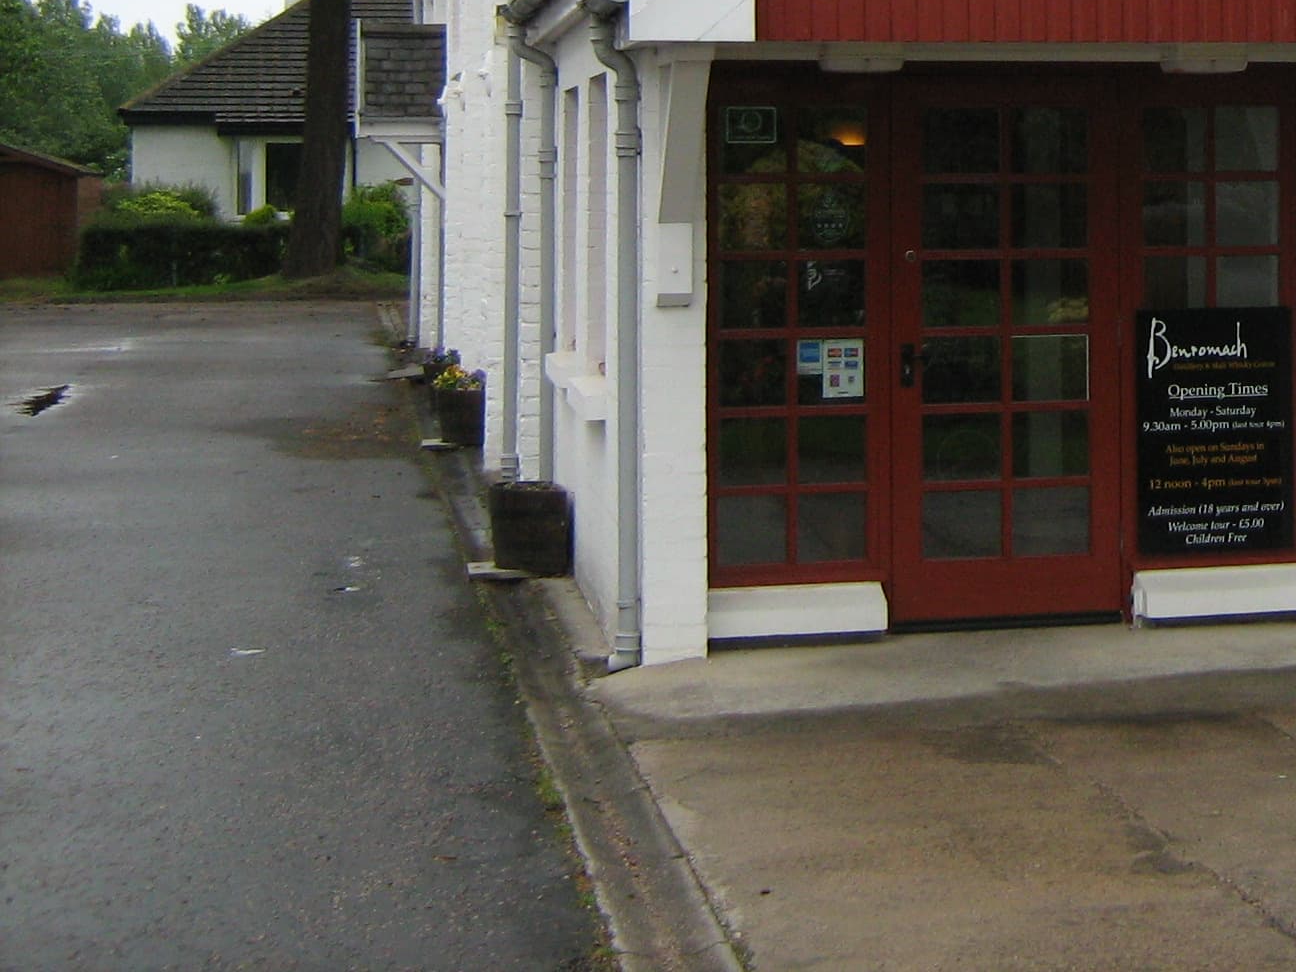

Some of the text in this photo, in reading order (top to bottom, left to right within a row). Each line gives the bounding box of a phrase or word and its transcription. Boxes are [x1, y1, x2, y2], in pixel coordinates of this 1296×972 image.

[1147, 317, 1247, 378] Benromach
[1168, 382, 1268, 400] Opening Times
[1170, 407, 1207, 419] Monday
[1215, 405, 1257, 418] Saturday
[1143, 421, 1181, 432] 9.30am
[1191, 420, 1230, 433] 5.00pm
[1220, 442, 1255, 453] Sundays
[1150, 479, 1162, 490] 12
[1164, 480, 1192, 489] noon
[1202, 477, 1226, 490] 4pm
[1148, 500, 1285, 517] Admission (18 years and over)
[1168, 520, 1208, 532] Welcome
[1239, 517, 1265, 529] £5.00
[1185, 532, 1247, 545] Children Free
